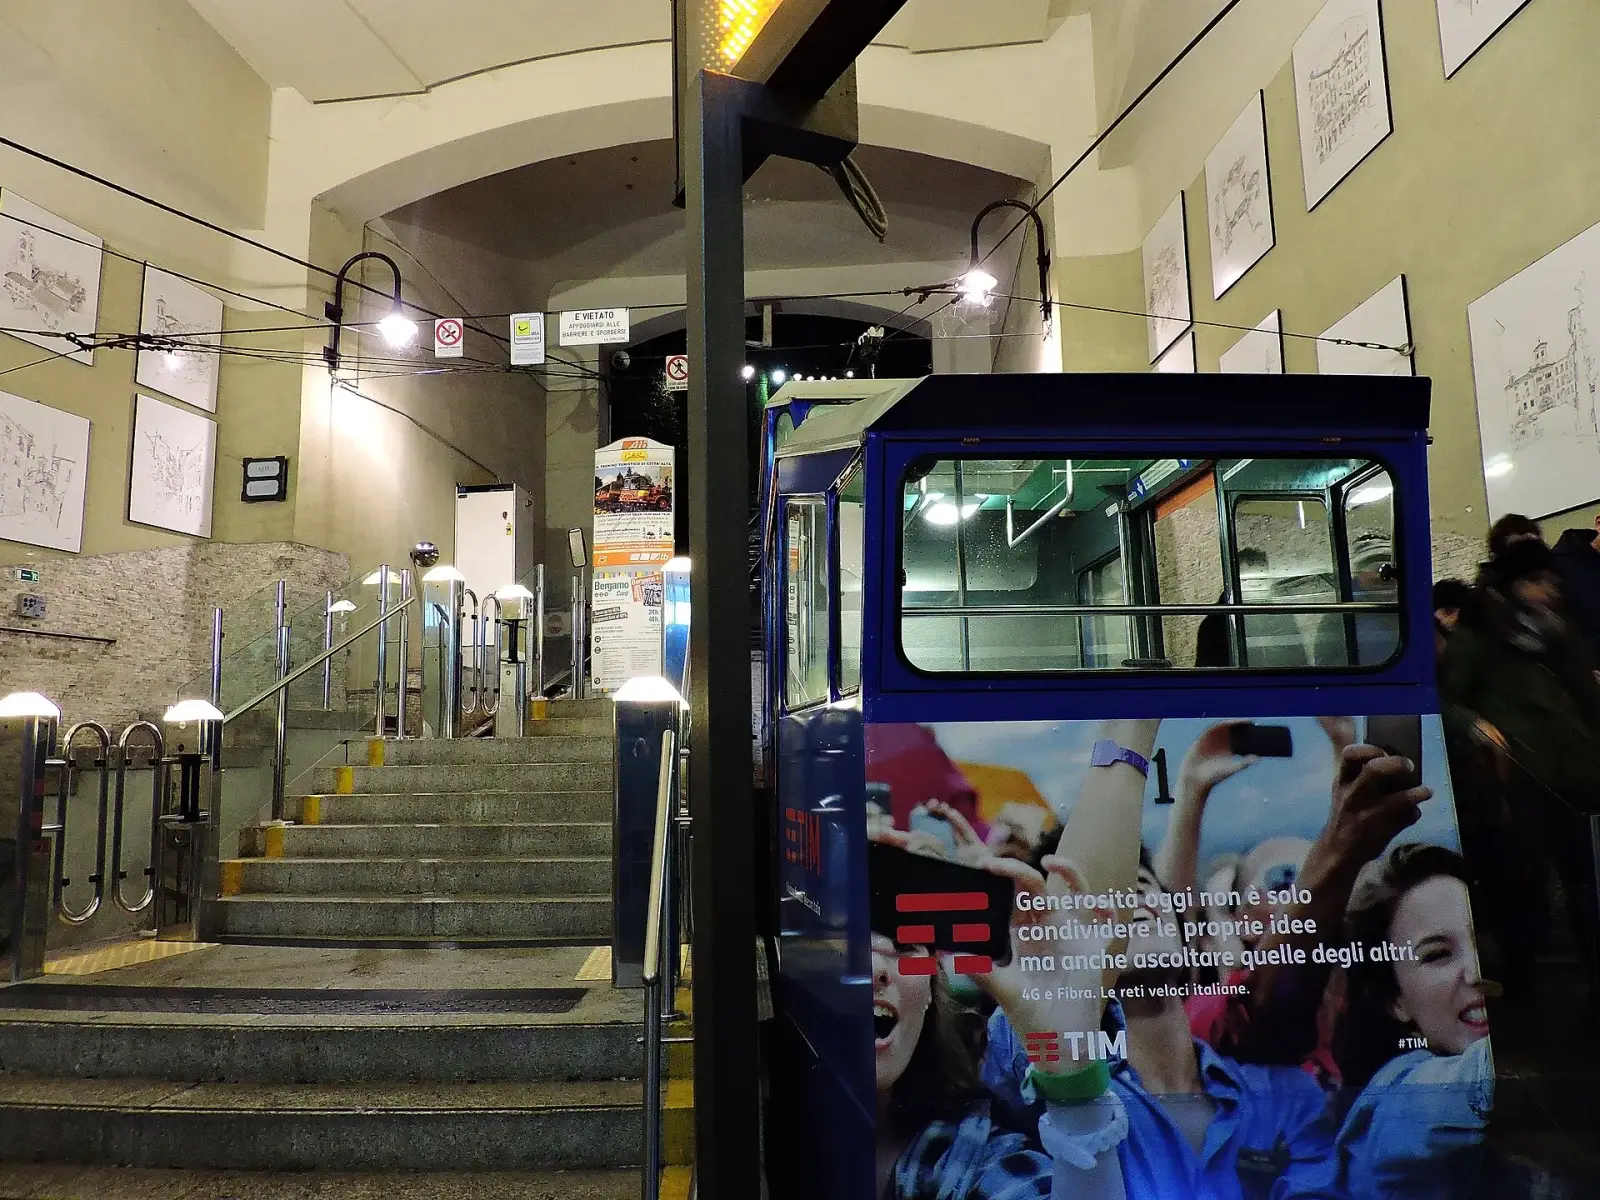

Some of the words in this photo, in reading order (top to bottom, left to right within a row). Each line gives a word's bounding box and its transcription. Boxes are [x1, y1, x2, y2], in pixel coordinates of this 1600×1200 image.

[582, 312, 614, 320] VIETATO
[594, 582, 629, 592] Bergamo
[1151, 748, 1175, 804] 1
[798, 811, 820, 876] TIM
[1016, 887, 1139, 912] Generosità
[1145, 887, 1193, 914] oggi
[1200, 890, 1242, 908] non
[1247, 884, 1262, 906] è
[1266, 884, 1312, 906] solo
[1016, 916, 1150, 941] condividere
[1156, 915, 1177, 938] le
[1184, 914, 1264, 940] proprie
[1270, 914, 1317, 935] idee
[1020, 953, 1055, 972] ma
[1060, 948, 1127, 971] anche
[1133, 944, 1235, 970] ascoltare
[1240, 943, 1306, 971] quelle
[1312, 940, 1364, 969] degli
[1370, 939, 1420, 963] altri.
[1021, 987, 1041, 1001] 4G
[1044, 990, 1053, 1000] e
[1057, 986, 1097, 1000] Fibra.
[1100, 985, 1116, 1000] Le
[1120, 984, 1145, 998] reti
[1148, 982, 1190, 998] veloci
[1193, 982, 1251, 996] italiane.
[1064, 1030, 1128, 1062] TIM
[1398, 1037, 1428, 1050] #TIM
